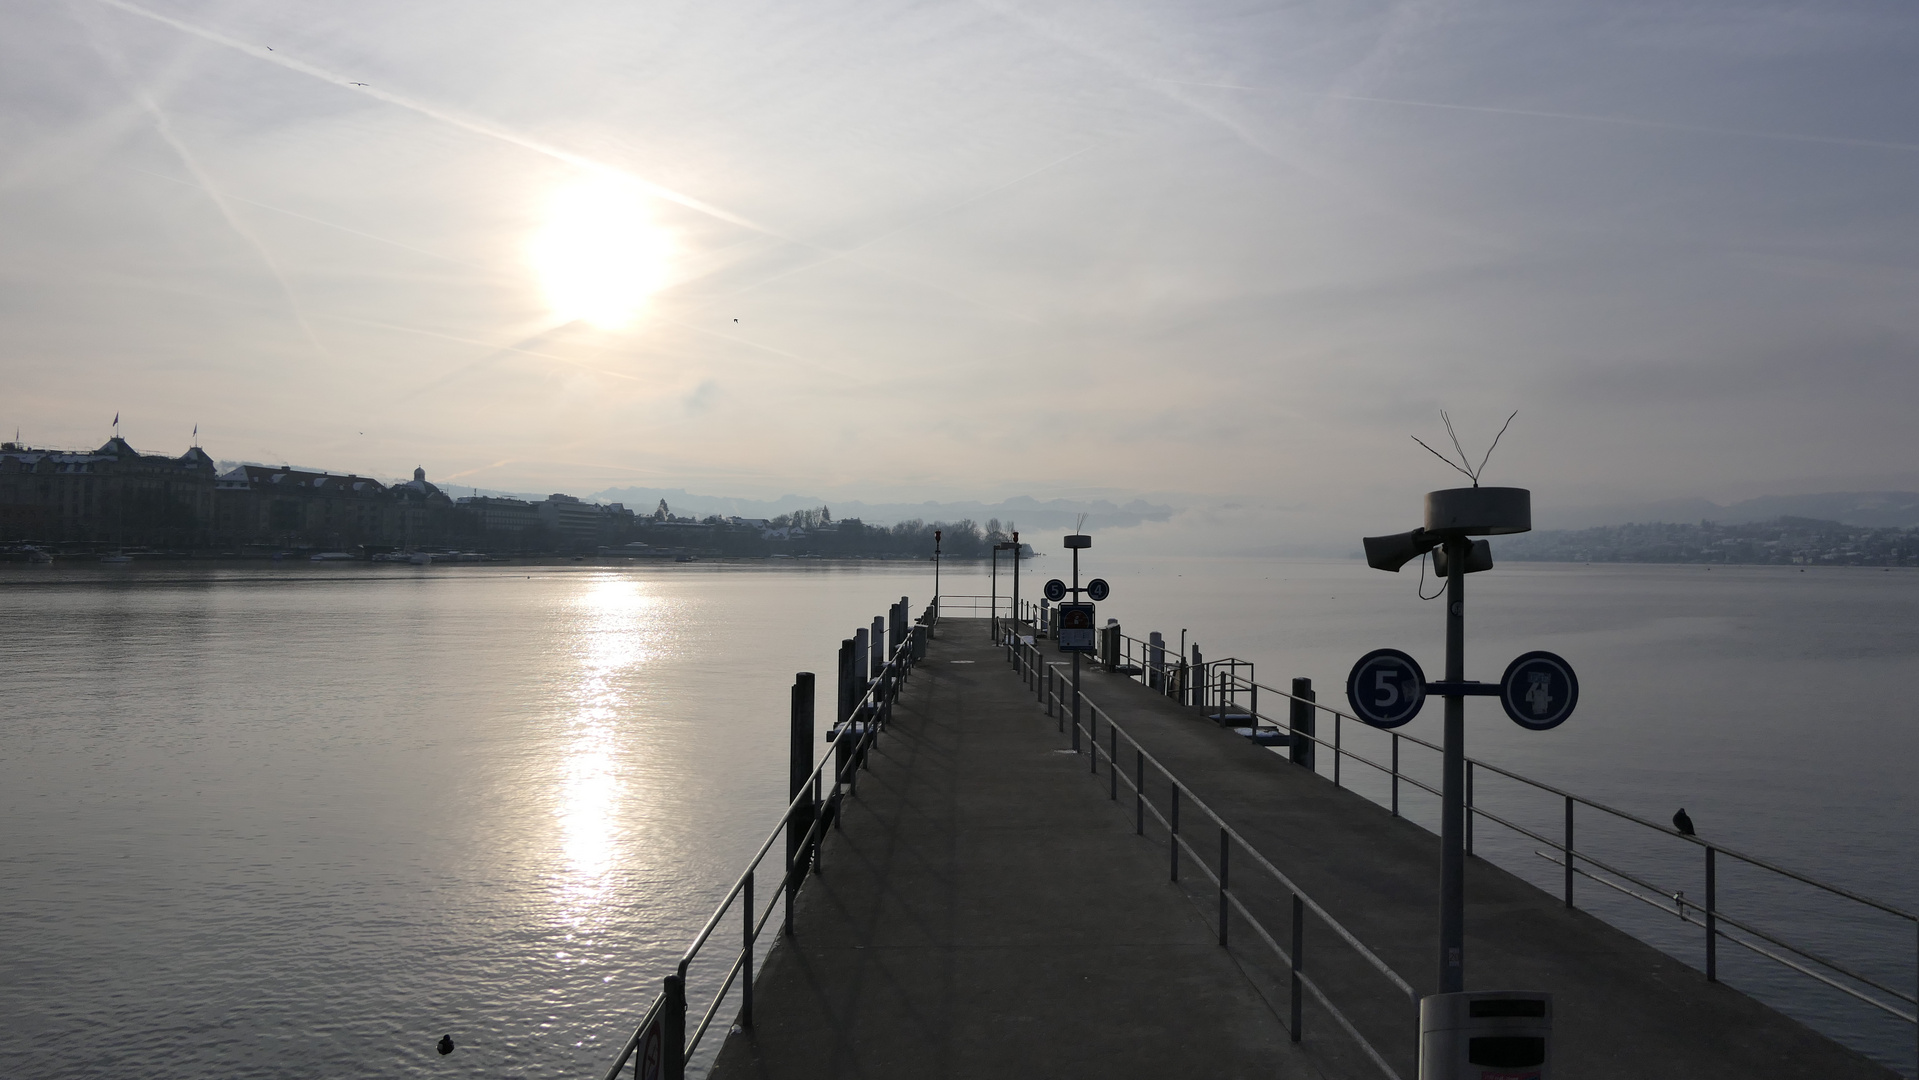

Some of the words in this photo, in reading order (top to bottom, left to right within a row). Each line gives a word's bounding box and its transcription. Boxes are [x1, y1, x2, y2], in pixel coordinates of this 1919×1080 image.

[1051, 584, 1059, 596] 5
[1094, 584, 1103, 596] 4
[1374, 670, 1399, 707] 5
[1525, 671, 1553, 711] 4
